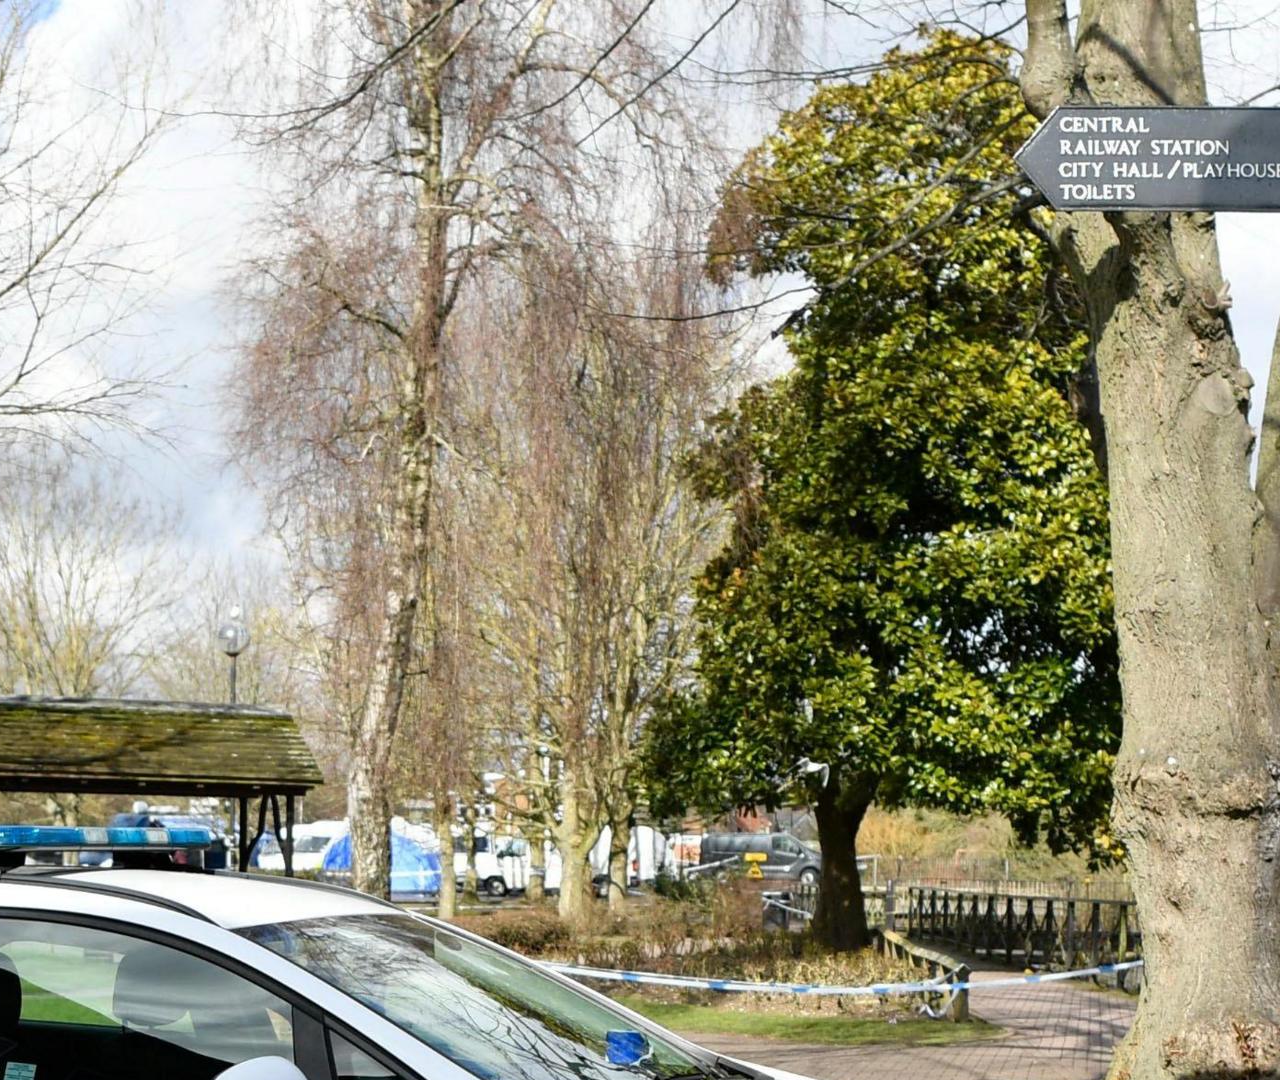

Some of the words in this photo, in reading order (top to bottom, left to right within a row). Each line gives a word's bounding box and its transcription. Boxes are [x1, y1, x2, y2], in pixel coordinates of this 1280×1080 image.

[1059, 116, 1150, 133] CENTRAL
[1059, 139, 1141, 156] RAILWAY
[1151, 139, 1230, 156] STATION
[1058, 161, 1105, 179] CITY
[1059, 183, 1136, 201] TOILETS
